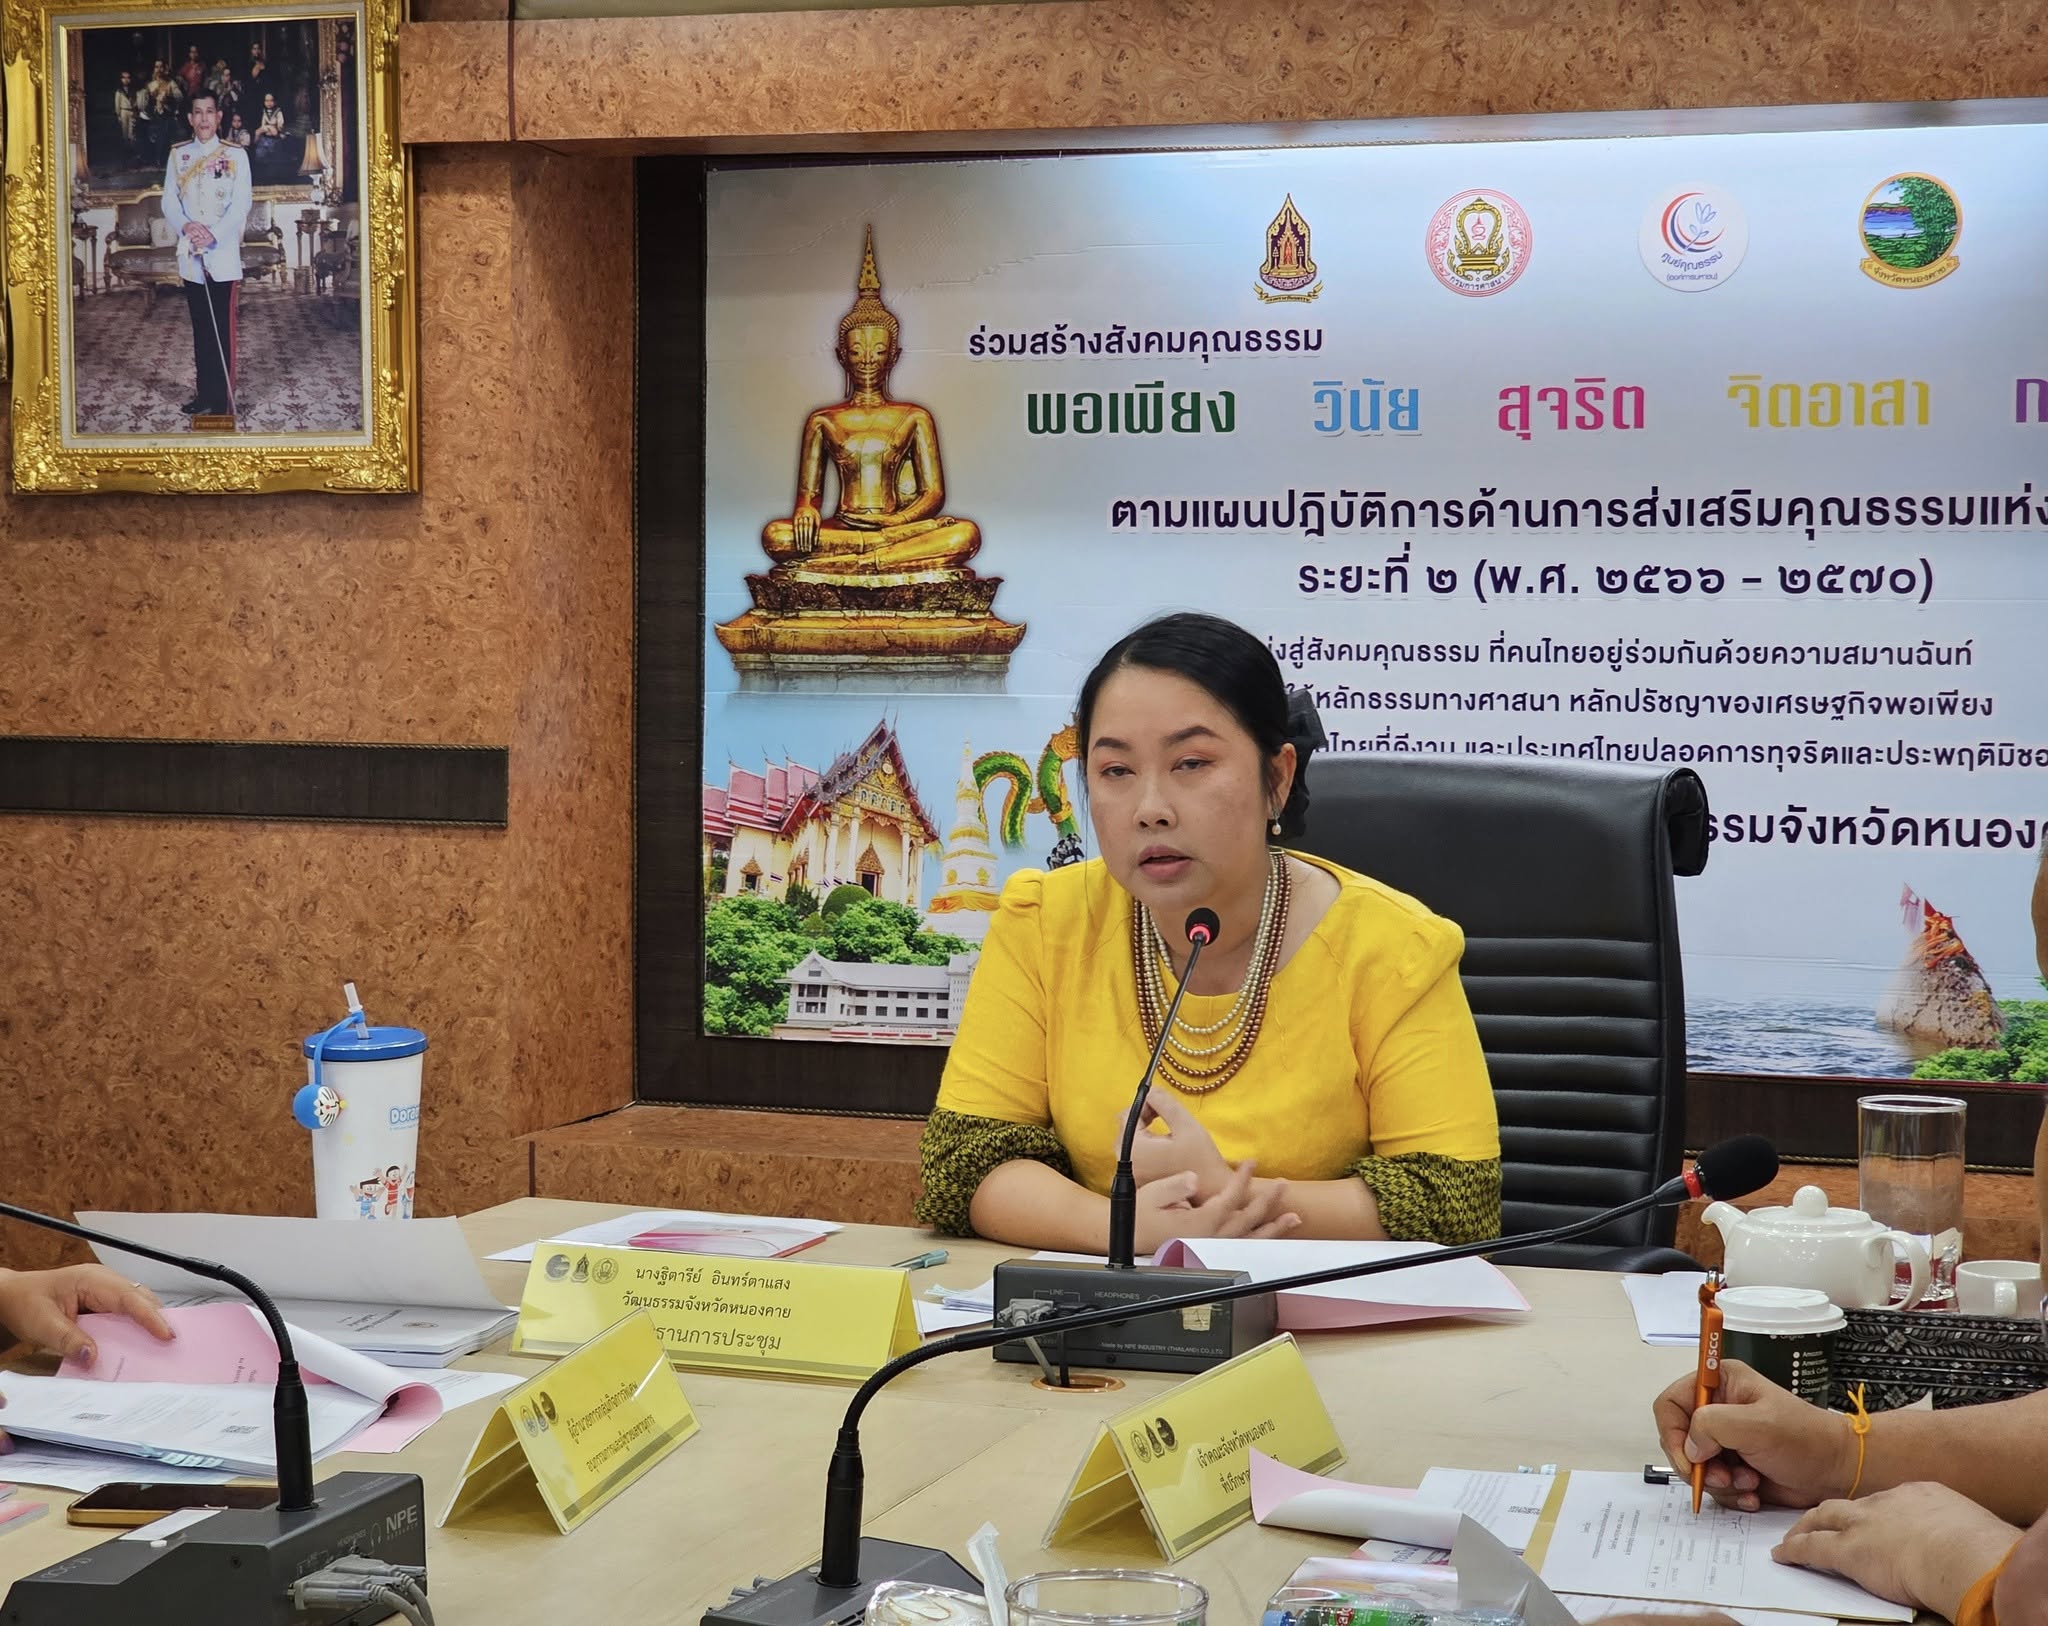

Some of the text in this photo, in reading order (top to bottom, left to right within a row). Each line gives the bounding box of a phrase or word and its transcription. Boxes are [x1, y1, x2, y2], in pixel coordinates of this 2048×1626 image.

[969, 323, 1323, 363] ร่วมสร้างสังคมคุณธรรม
[1028, 381, 1235, 434] พอเพียง
[1313, 379, 1419, 431] วินัย
[1498, 378, 1645, 440] สุจริต
[1728, 375, 1930, 428] จิตอาสา
[1299, 542, 1410, 594] ระยะที่
[1426, 566, 1457, 594] ๒
[1474, 559, 1579, 603] (พ.ศ.
[1596, 564, 1725, 594] ๒๕๖๖
[1778, 558, 1933, 604] ๒๕๗๐)
[1268, 630, 1973, 672] ่งสู่สังคมคุณธรรม ที่คนไทยอยู่ร่วมกันด้วยความสมานฉันท์
[1570, 687, 1993, 721] หลักปรัชญาของเศรษฐกิจพอเพียง
[711, 1270, 791, 1290] อินทร์ตาแสง
[622, 1290, 791, 1319] วัฒนธรรมจังหวัดหนองคาย
[1094, 1292, 1140, 1300] HEADPHONES
[655, 1326, 781, 1356] ธานการประชุม
[1709, 1332, 1719, 1356] SCG
[385, 1504, 418, 1534] NPE
